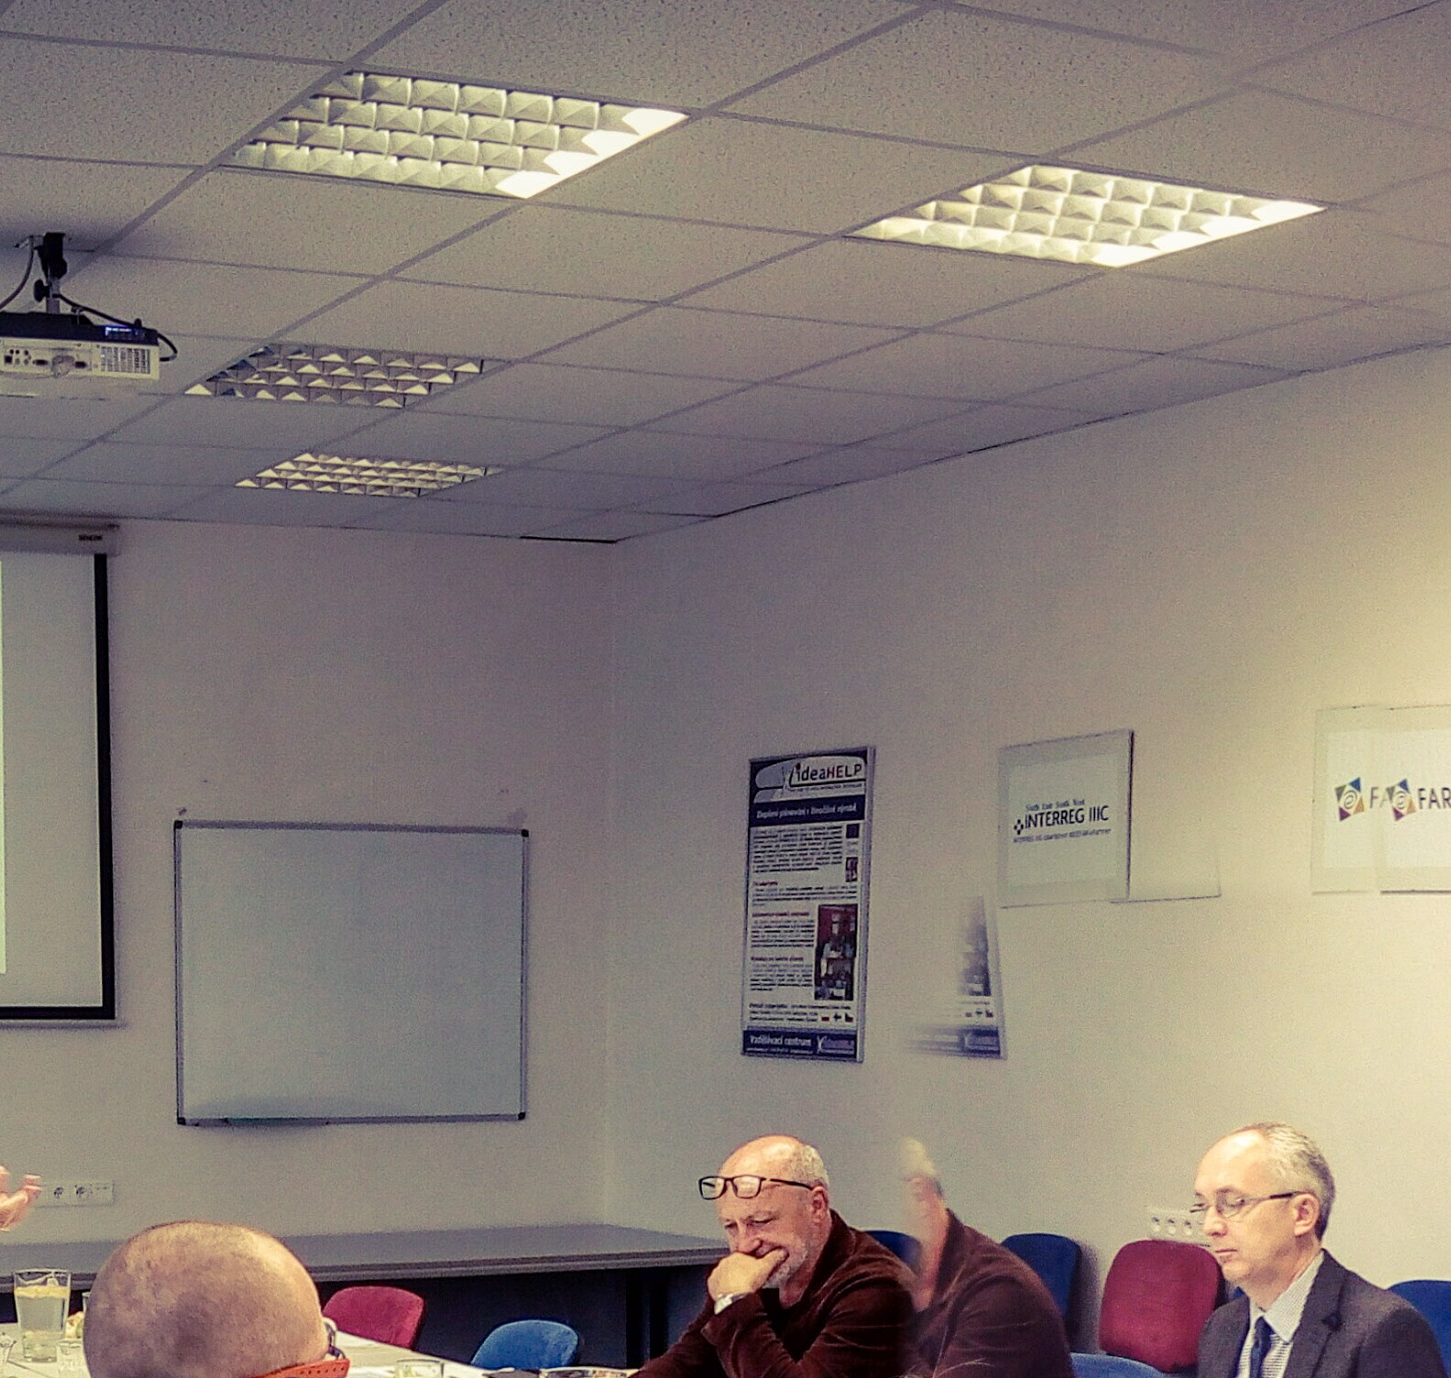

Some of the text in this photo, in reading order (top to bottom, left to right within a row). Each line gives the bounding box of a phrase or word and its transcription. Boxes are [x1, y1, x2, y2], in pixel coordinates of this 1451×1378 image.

[796, 762, 862, 783] ideaHELP
[1025, 805, 1109, 829] INTERREG IIIC
